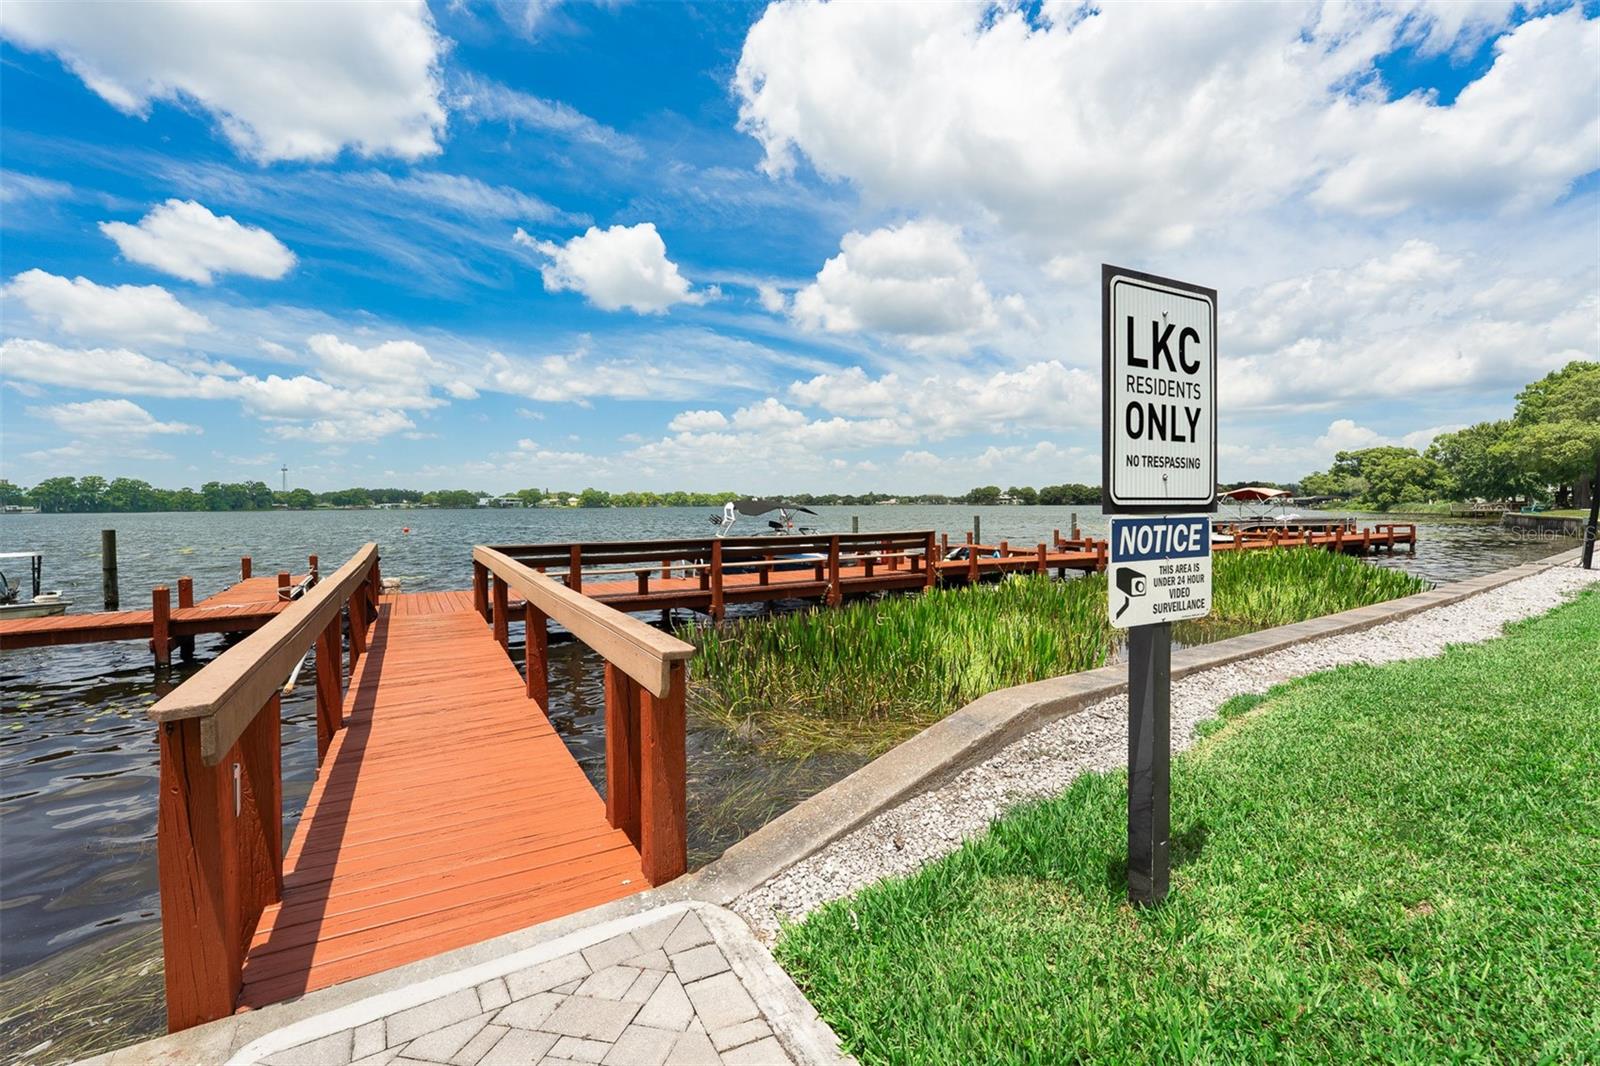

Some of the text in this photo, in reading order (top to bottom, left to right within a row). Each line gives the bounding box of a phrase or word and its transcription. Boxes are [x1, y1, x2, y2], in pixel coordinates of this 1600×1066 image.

[1127, 315, 1201, 375] LKC
[1126, 374, 1201, 400] RESIDENTS
[1125, 401, 1202, 443] ONLY
[1126, 454, 1201, 469] NO TRESPASSING
[1119, 523, 1203, 556] NOTICE
[1159, 562, 1200, 575] THIS AREA IS
[1153, 574, 1205, 587] UNDER 24 HOUR
[1169, 586, 1191, 599] VIDEO
[1152, 598, 1206, 614] SURVEILLANCE
